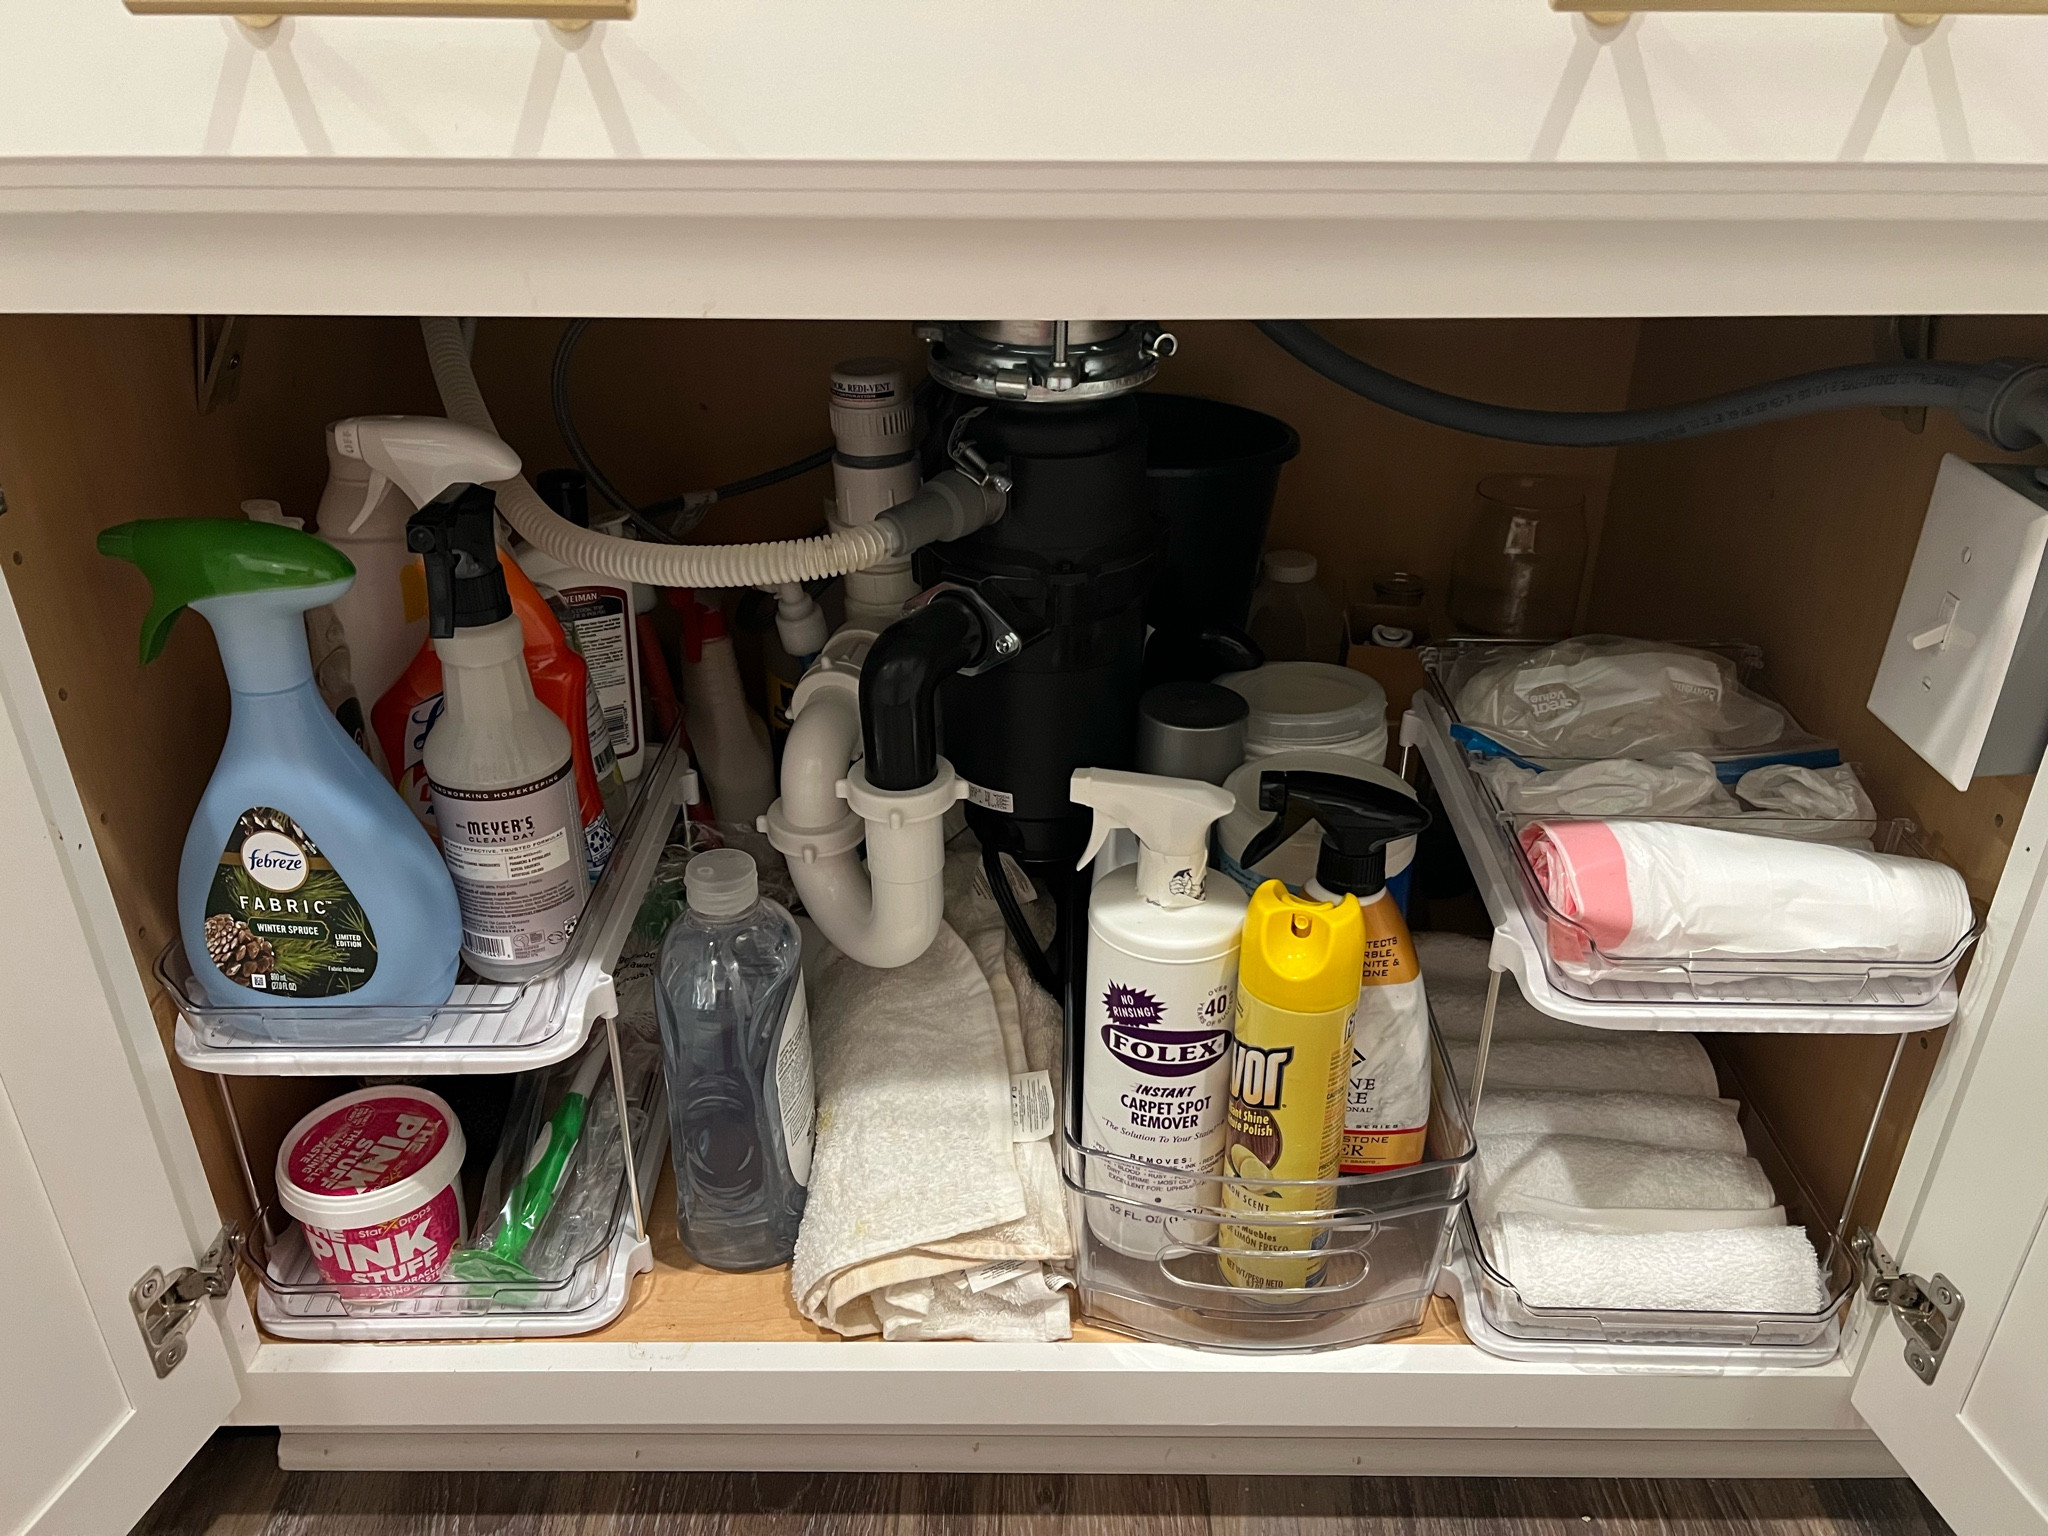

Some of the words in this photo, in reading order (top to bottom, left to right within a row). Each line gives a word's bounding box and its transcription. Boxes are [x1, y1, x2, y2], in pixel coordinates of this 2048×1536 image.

[848, 383, 890, 392] REDI-VENT
[494, 775, 559, 798] HOMEKEEPING
[469, 836, 506, 844] CLEAN
[513, 831, 535, 842] DAY
[500, 844, 532, 853] TRUSTED
[248, 849, 302, 871] febreze
[257, 923, 287, 934] WINTER
[288, 925, 319, 936] SPRUCE
[1366, 936, 1398, 949] TECTS
[1363, 948, 1395, 959] RBLE,
[1363, 959, 1389, 968] NITE
[1392, 958, 1400, 967] &
[1362, 969, 1389, 978] ONE
[1208, 985, 1228, 996] OVER
[1120, 995, 1134, 1006] NO
[1205, 994, 1227, 1017] 40
[1112, 1006, 1155, 1018] RINSING!
[1230, 1040, 1290, 1107] vor
[1135, 1084, 1197, 1098] INSTANT
[1120, 1094, 1174, 1115] CARPET
[1177, 1096, 1212, 1115] SPOT
[1130, 1111, 1199, 1130] REMOVER
[1243, 1110, 1270, 1125] Shine
[342, 1129, 363, 1147] THE
[1120, 1127, 1156, 1142] Solution
[1159, 1136, 1170, 1144] To
[1173, 1136, 1193, 1144] Your
[1243, 1122, 1273, 1137] Polish
[330, 1113, 429, 1194] PINK
[320, 1137, 375, 1189] STUFF
[1117, 1163, 1141, 1176] BLOOD
[1108, 1172, 1145, 1190] EXCELLENT
[1127, 1174, 1149, 1184] GRIME
[1243, 1195, 1270, 1212] SCENT
[1109, 1203, 1121, 1215] 32
[1124, 1210, 1142, 1222] FL.
[358, 1227, 383, 1239] Star
[398, 1205, 432, 1228] Drops
[1234, 1229, 1257, 1248] LIMÓN
[1241, 1225, 1277, 1242] Muebles
[306, 1215, 438, 1272] PINK
[351, 1247, 438, 1284] STUFF
[1265, 1279, 1284, 1288] NETO
